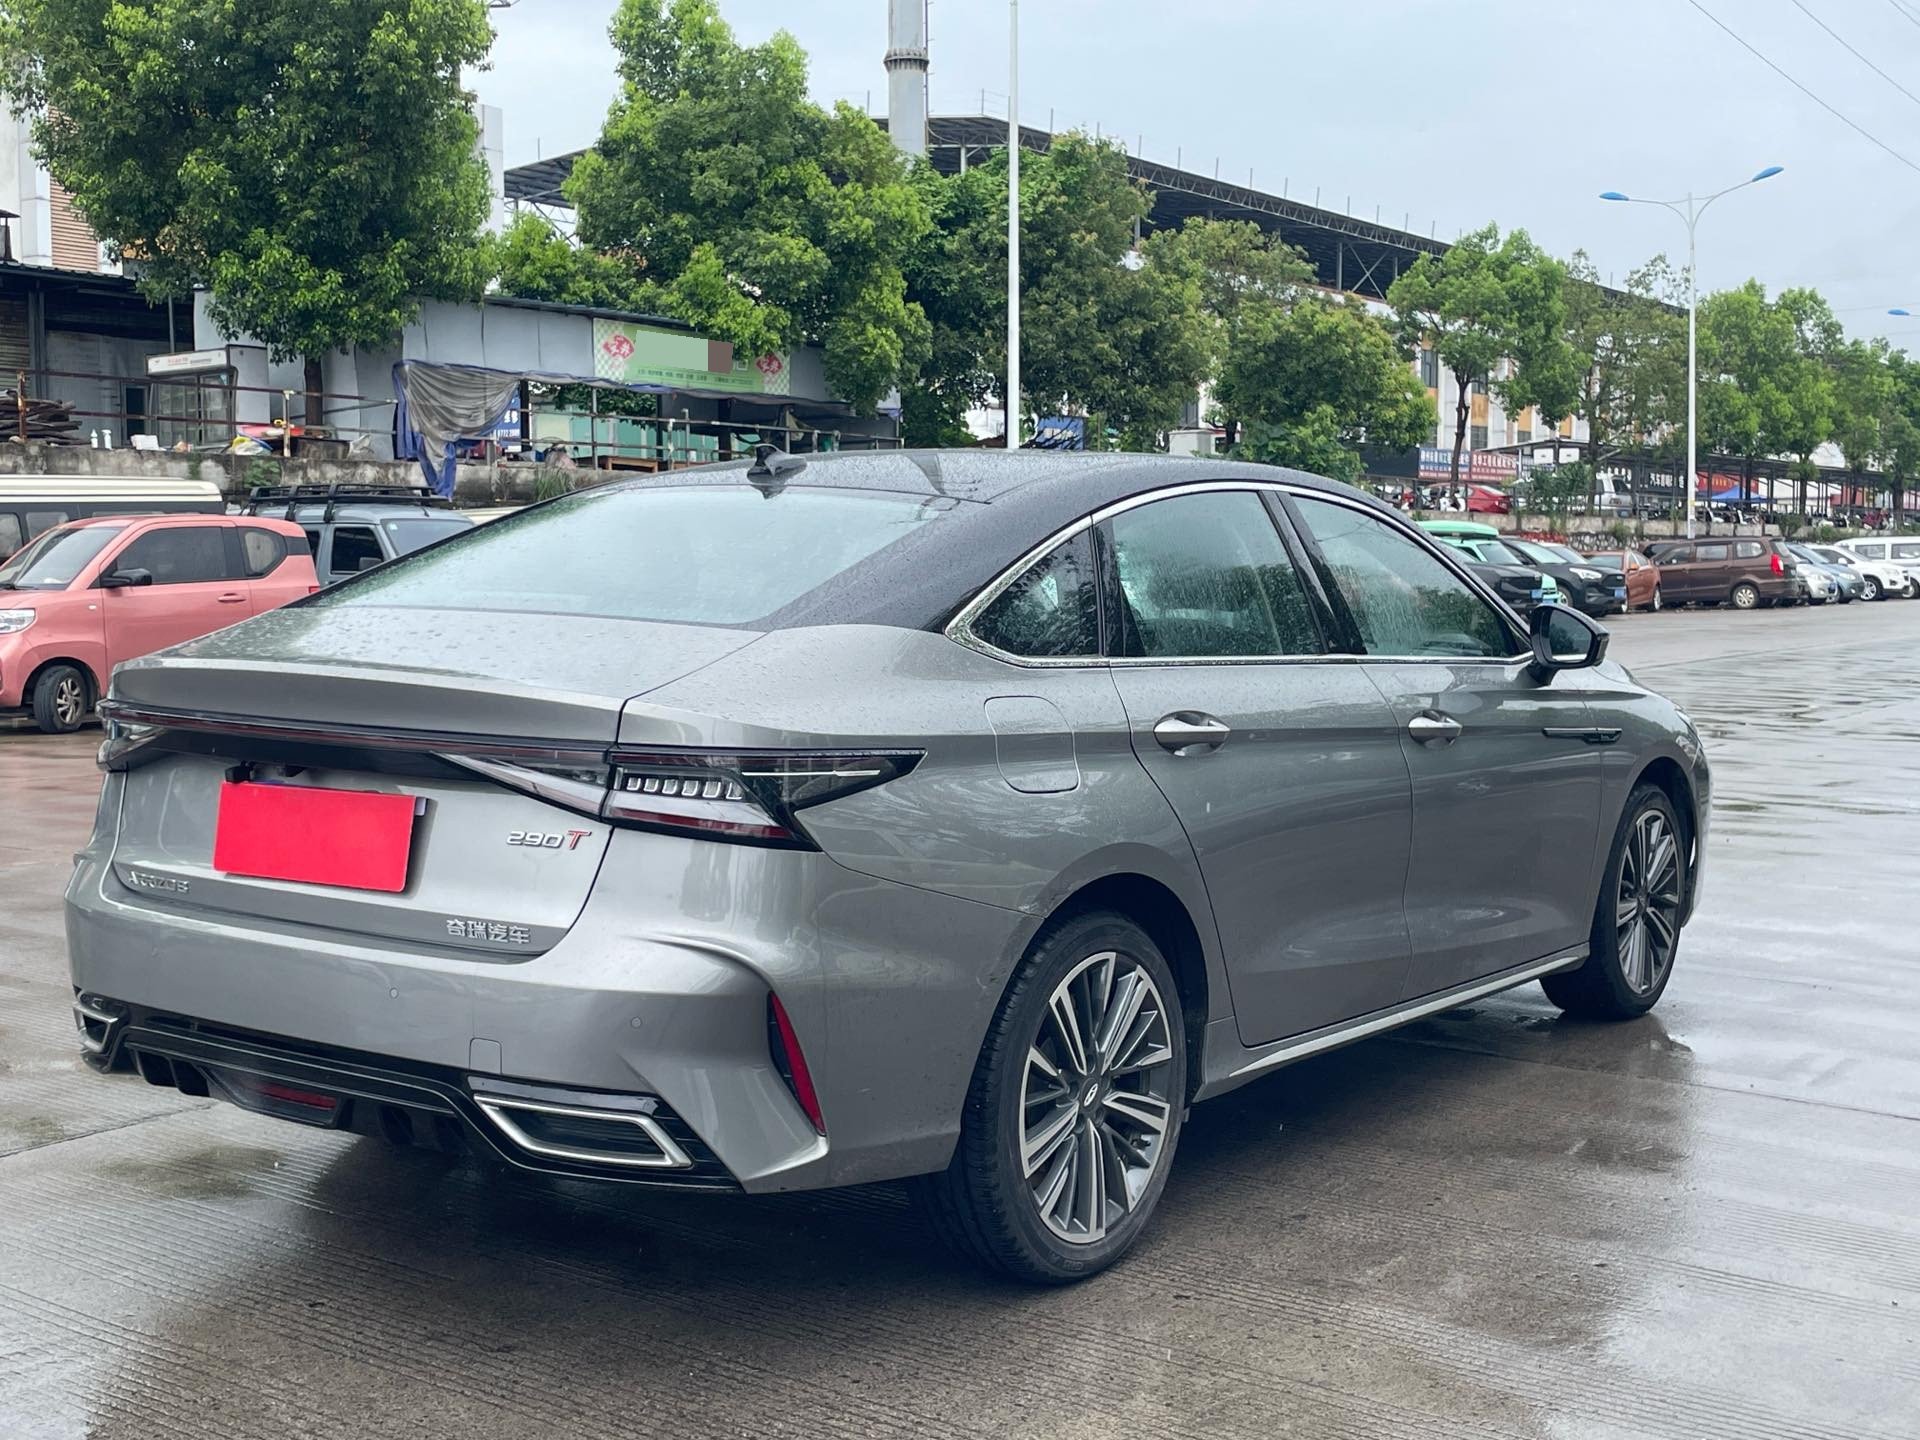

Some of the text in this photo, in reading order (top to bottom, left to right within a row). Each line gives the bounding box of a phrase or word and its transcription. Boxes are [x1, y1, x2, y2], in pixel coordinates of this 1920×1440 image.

[506, 829, 592, 850] 290T
[446, 918, 531, 944] 奇瑞汽车
